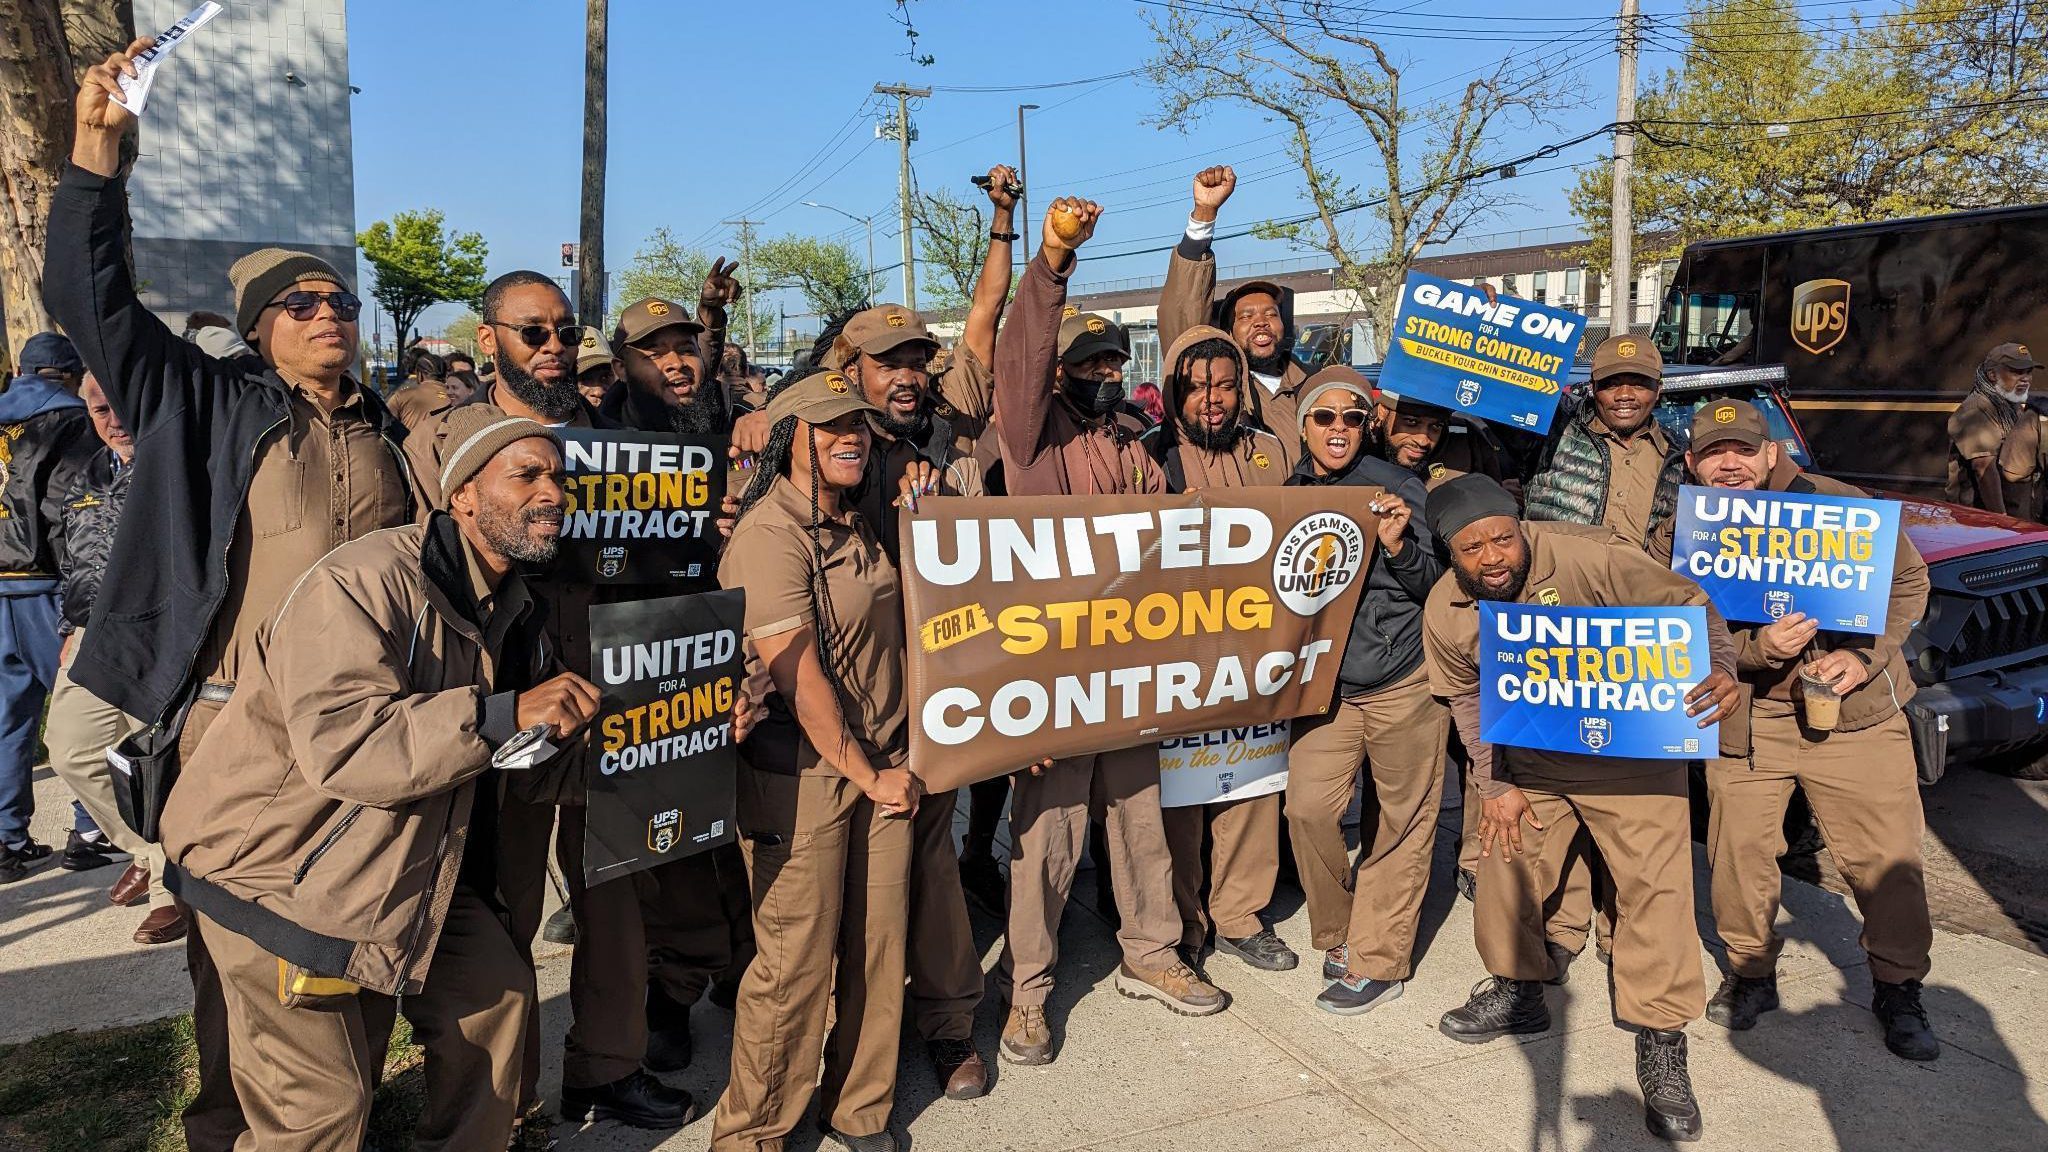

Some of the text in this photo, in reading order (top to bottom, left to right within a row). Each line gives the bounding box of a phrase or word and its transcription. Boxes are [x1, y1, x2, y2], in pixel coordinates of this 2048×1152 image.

[1413, 284, 1575, 344] GAME ON
[1479, 323, 1500, 337] FOR A
[1795, 301, 1845, 342] ups
[1405, 316, 1473, 350] STRONG
[1475, 335, 1563, 375] CONTRACT
[1415, 345, 1538, 387] BUCKLE YOUR CHIN STRAPS!
[1463, 379, 1480, 389] UPS
[565, 440, 713, 474] NITED
[563, 469, 708, 516] STRONG
[560, 510, 710, 539] NTRACT
[1694, 495, 1881, 533] UNITED
[603, 546, 625, 555] UPS
[911, 507, 1274, 586] UNITED
[1280, 517, 1359, 567] UPS TEAMSTERS
[1692, 527, 1873, 562] FOR A STRONG
[1279, 569, 1351, 593] UNITED
[1689, 551, 1875, 591] CONTRACT
[1768, 590, 1790, 599] UPS
[933, 586, 1274, 655] FOR A STRONG
[1497, 612, 1692, 647] UNITED
[602, 628, 736, 685] UNITED
[1497, 642, 1692, 683] FOR A STRONG
[658, 678, 687, 694] FOR A
[921, 639, 1332, 746] CONTRACT
[602, 676, 733, 754] STRONG
[1583, 717, 1607, 726] UPS
[600, 722, 731, 776] CONTRACT
[1189, 745, 1222, 768] the
[1226, 739, 1290, 766] Dream
[1218, 771, 1234, 779] UPS
[653, 808, 679, 825] UPS
